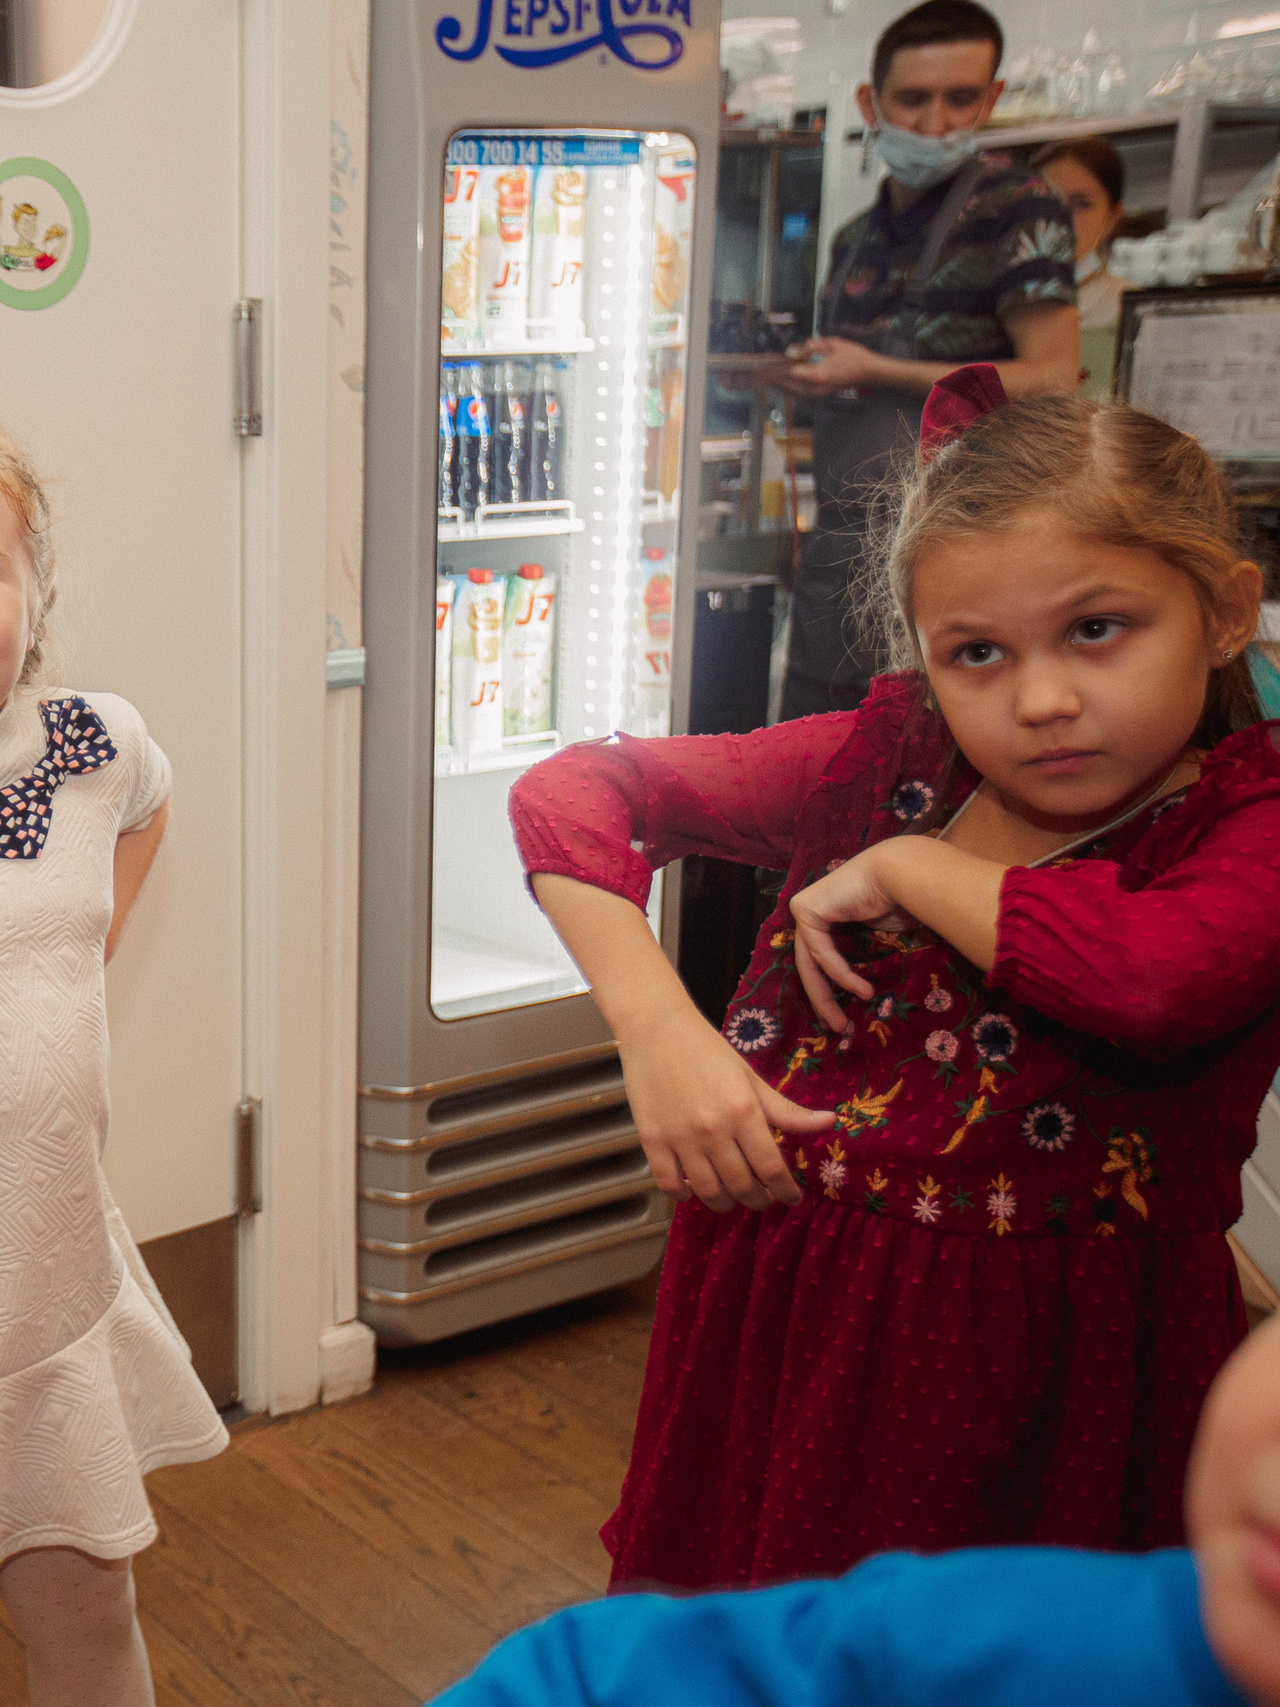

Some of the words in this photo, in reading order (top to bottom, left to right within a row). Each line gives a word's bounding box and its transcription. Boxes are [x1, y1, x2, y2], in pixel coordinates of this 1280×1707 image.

[447, 140, 478, 164] 00
[480, 140, 515, 164] 700
[517, 140, 539, 164] 14
[541, 140, 564, 164] 55
[443, 167, 479, 202] J7
[492, 261, 521, 289] J7
[551, 261, 583, 287] J7
[515, 592, 555, 626] J7
[470, 680, 500, 706] J7
